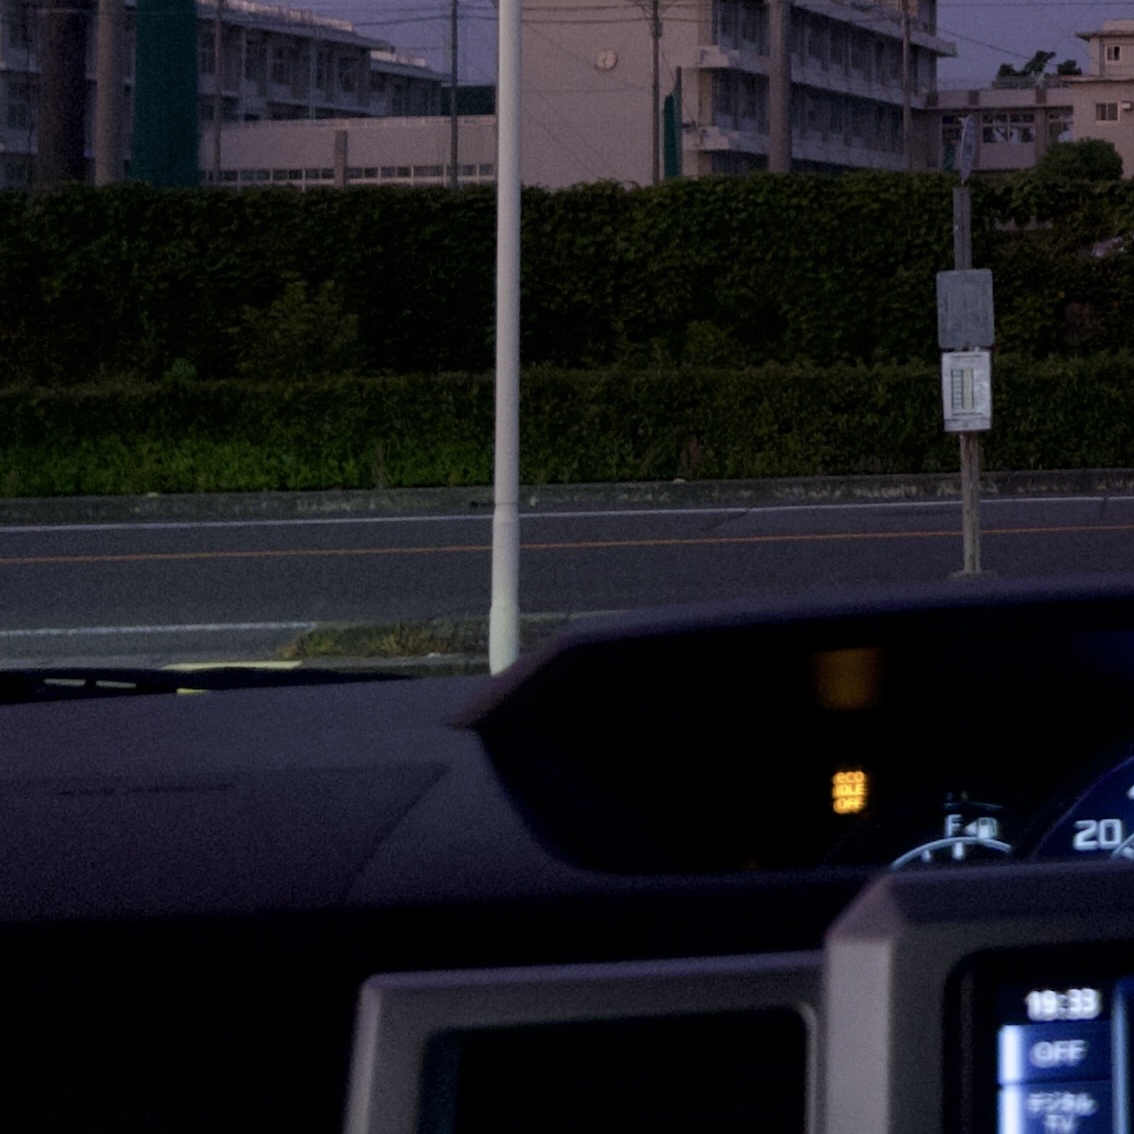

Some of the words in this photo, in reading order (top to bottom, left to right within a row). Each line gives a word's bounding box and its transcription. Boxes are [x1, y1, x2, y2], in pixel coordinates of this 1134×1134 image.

[944, 814, 963, 838] F
[1073, 818, 1125, 851] 20
[1029, 1039, 1088, 1068] OFF
